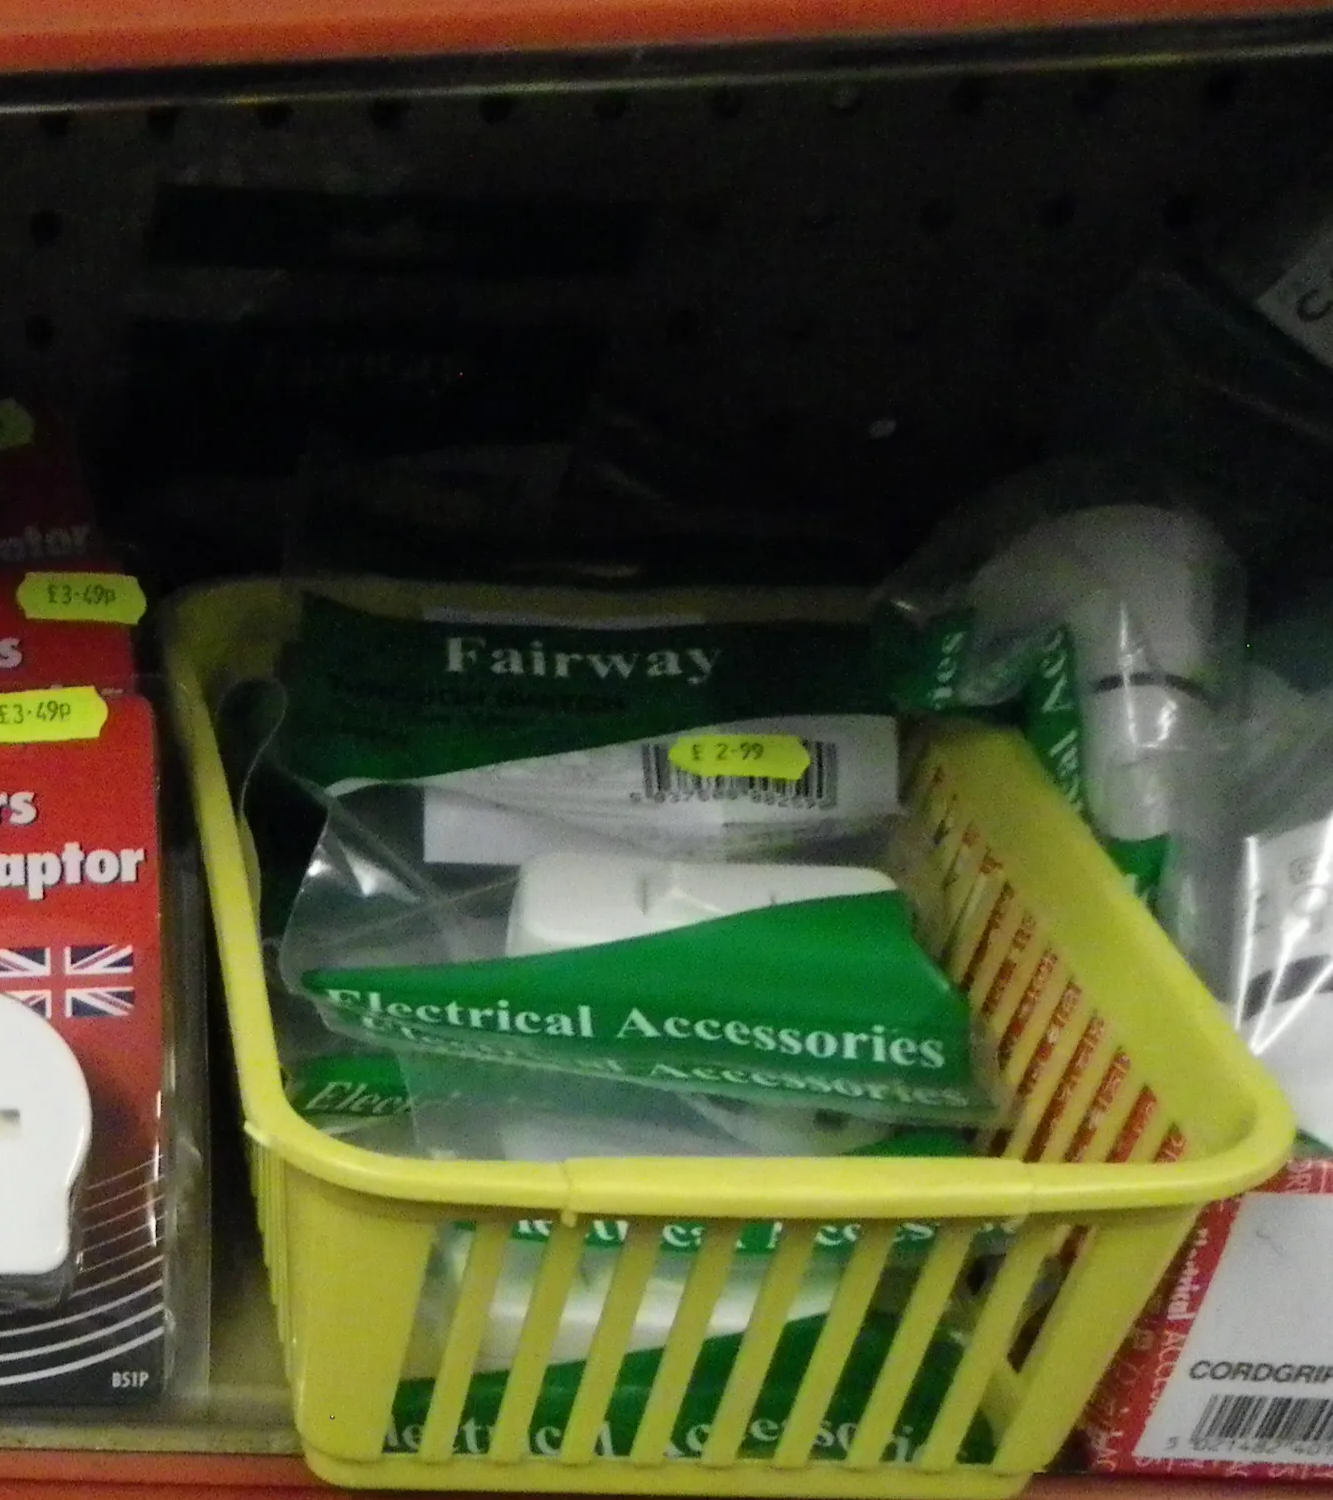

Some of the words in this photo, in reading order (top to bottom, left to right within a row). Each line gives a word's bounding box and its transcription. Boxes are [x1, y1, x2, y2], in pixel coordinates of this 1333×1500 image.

[445, 634, 721, 686] Fairway
[327, 987, 594, 1040] Electrical
[615, 1006, 945, 1070] Accessories
